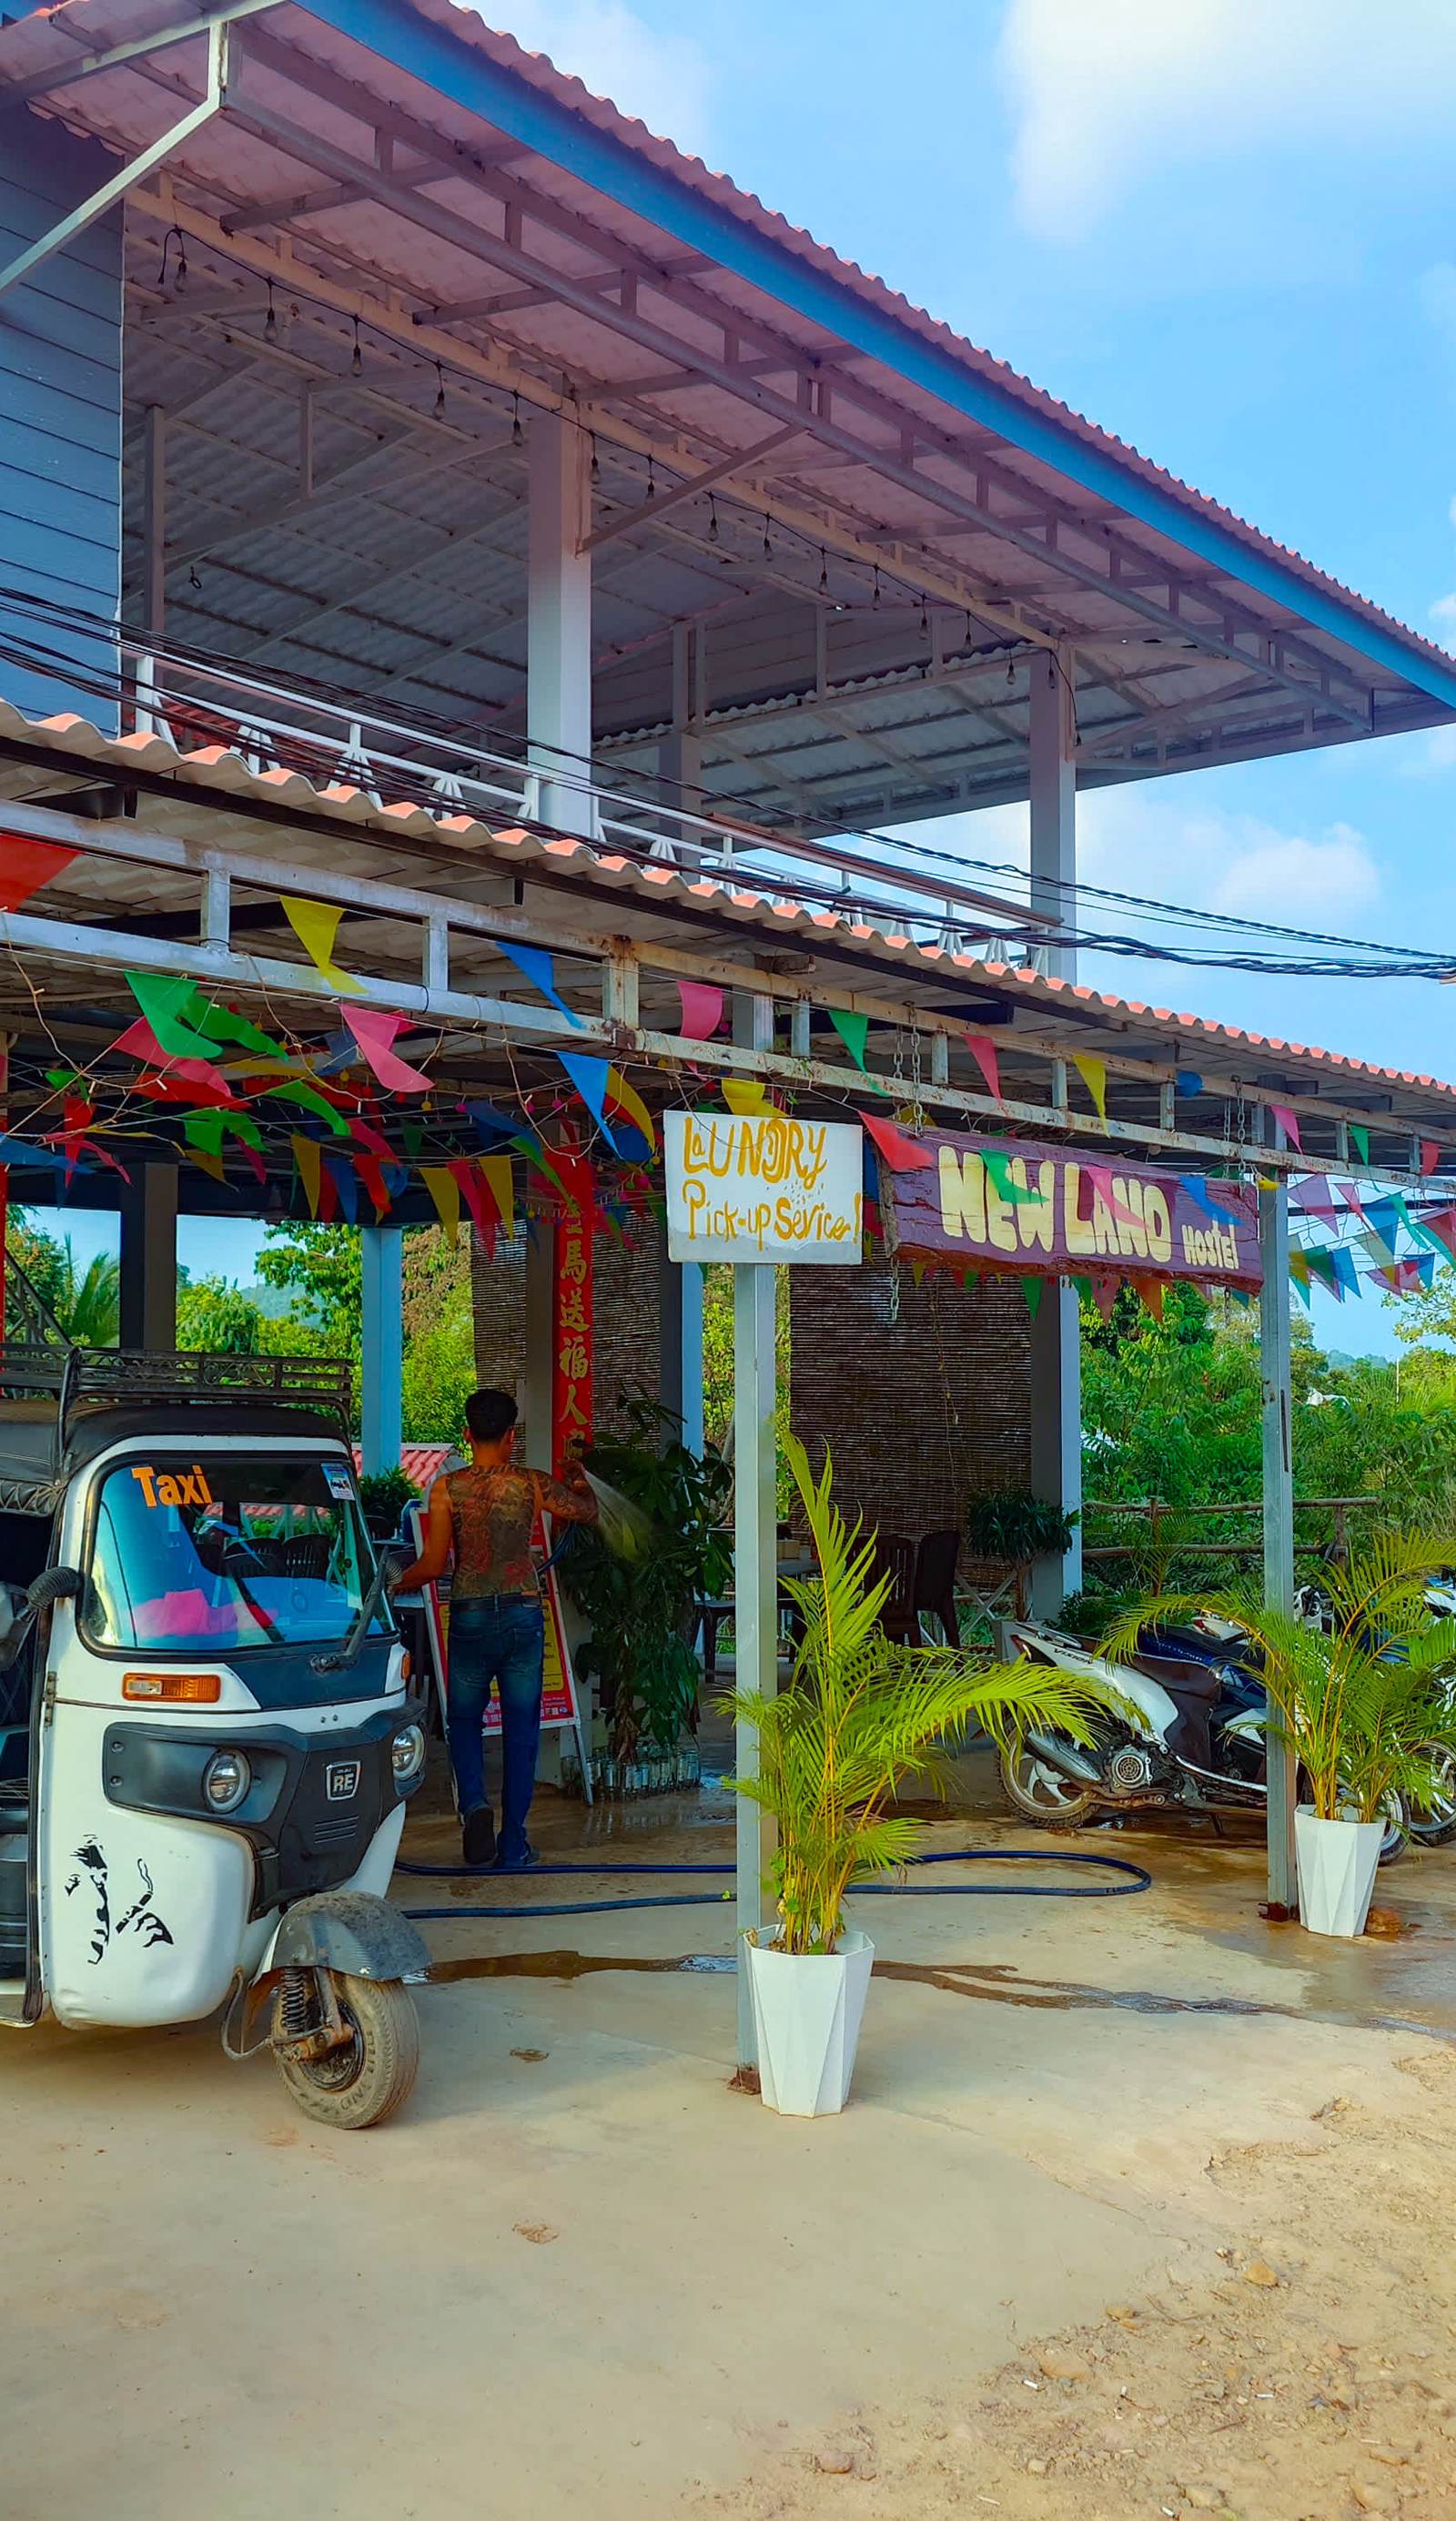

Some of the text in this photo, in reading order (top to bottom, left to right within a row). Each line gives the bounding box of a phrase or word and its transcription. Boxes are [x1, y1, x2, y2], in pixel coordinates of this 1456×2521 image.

[938, 1146, 1055, 1252] NEW
[1064, 1162, 1172, 1263] LAND
[131, 1464, 213, 1507] Taxi
[333, 1773, 354, 1792] RE
